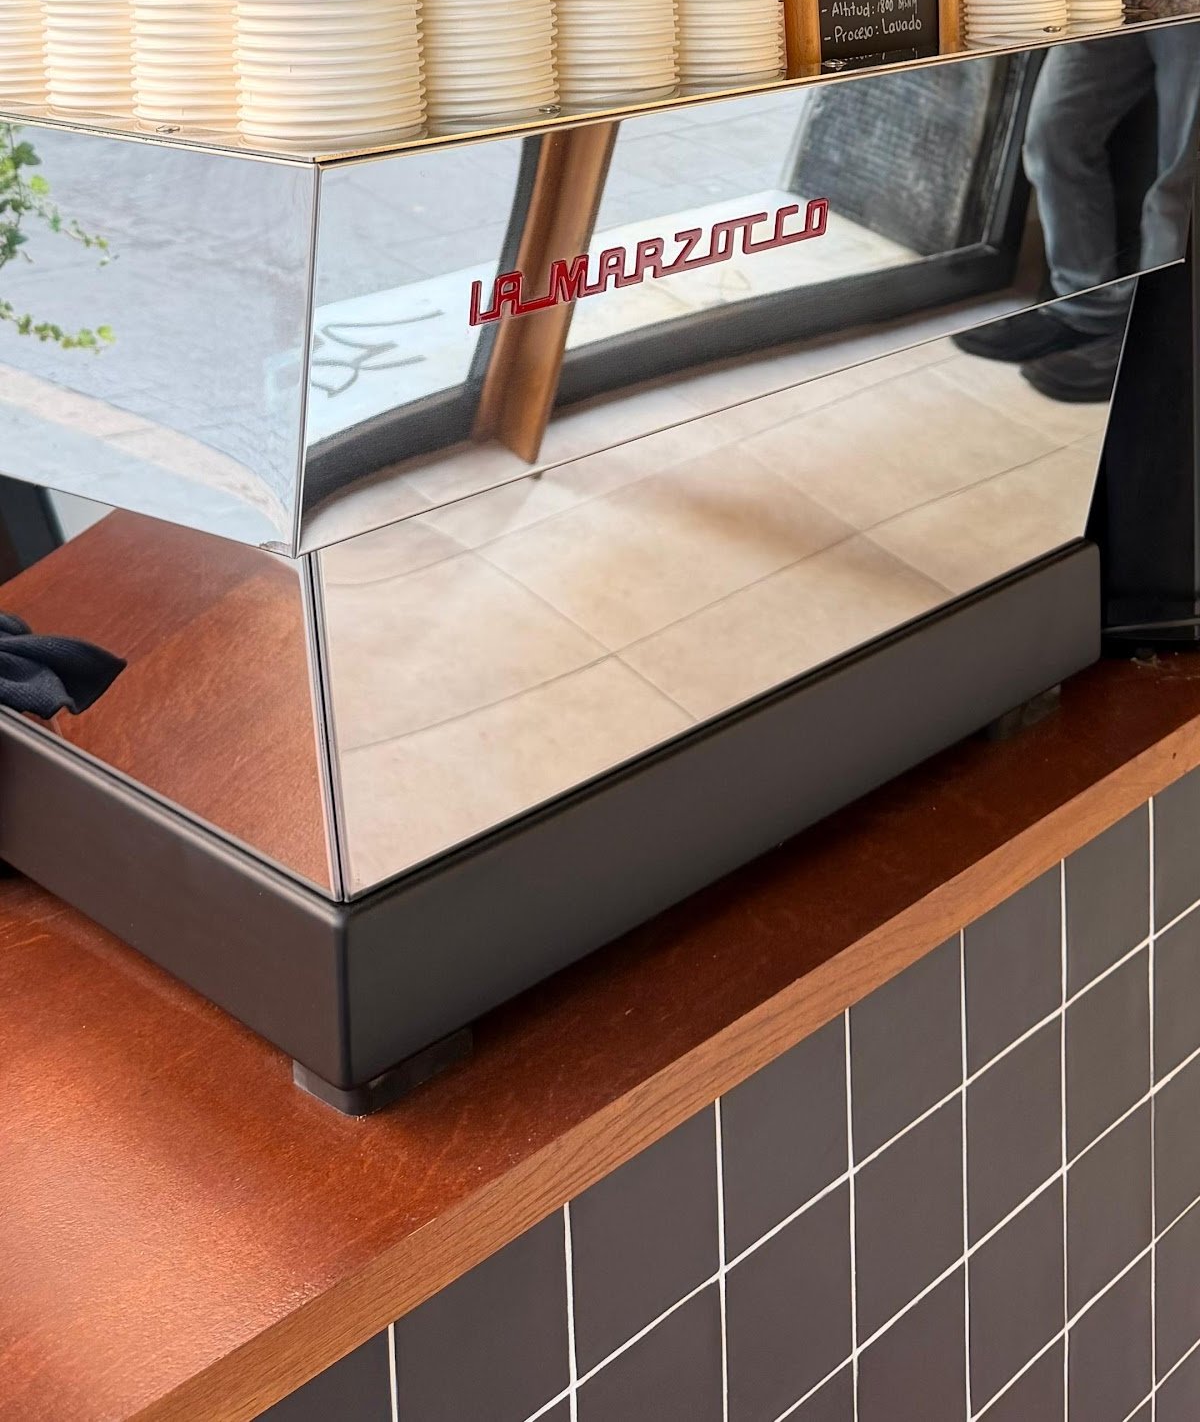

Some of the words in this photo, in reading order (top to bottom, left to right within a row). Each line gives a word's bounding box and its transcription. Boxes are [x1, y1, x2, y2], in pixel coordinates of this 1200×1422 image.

[881, 14, 922, 35] Lavado
[469, 270, 525, 326] LA
[550, 197, 830, 304] MARZOCCO
